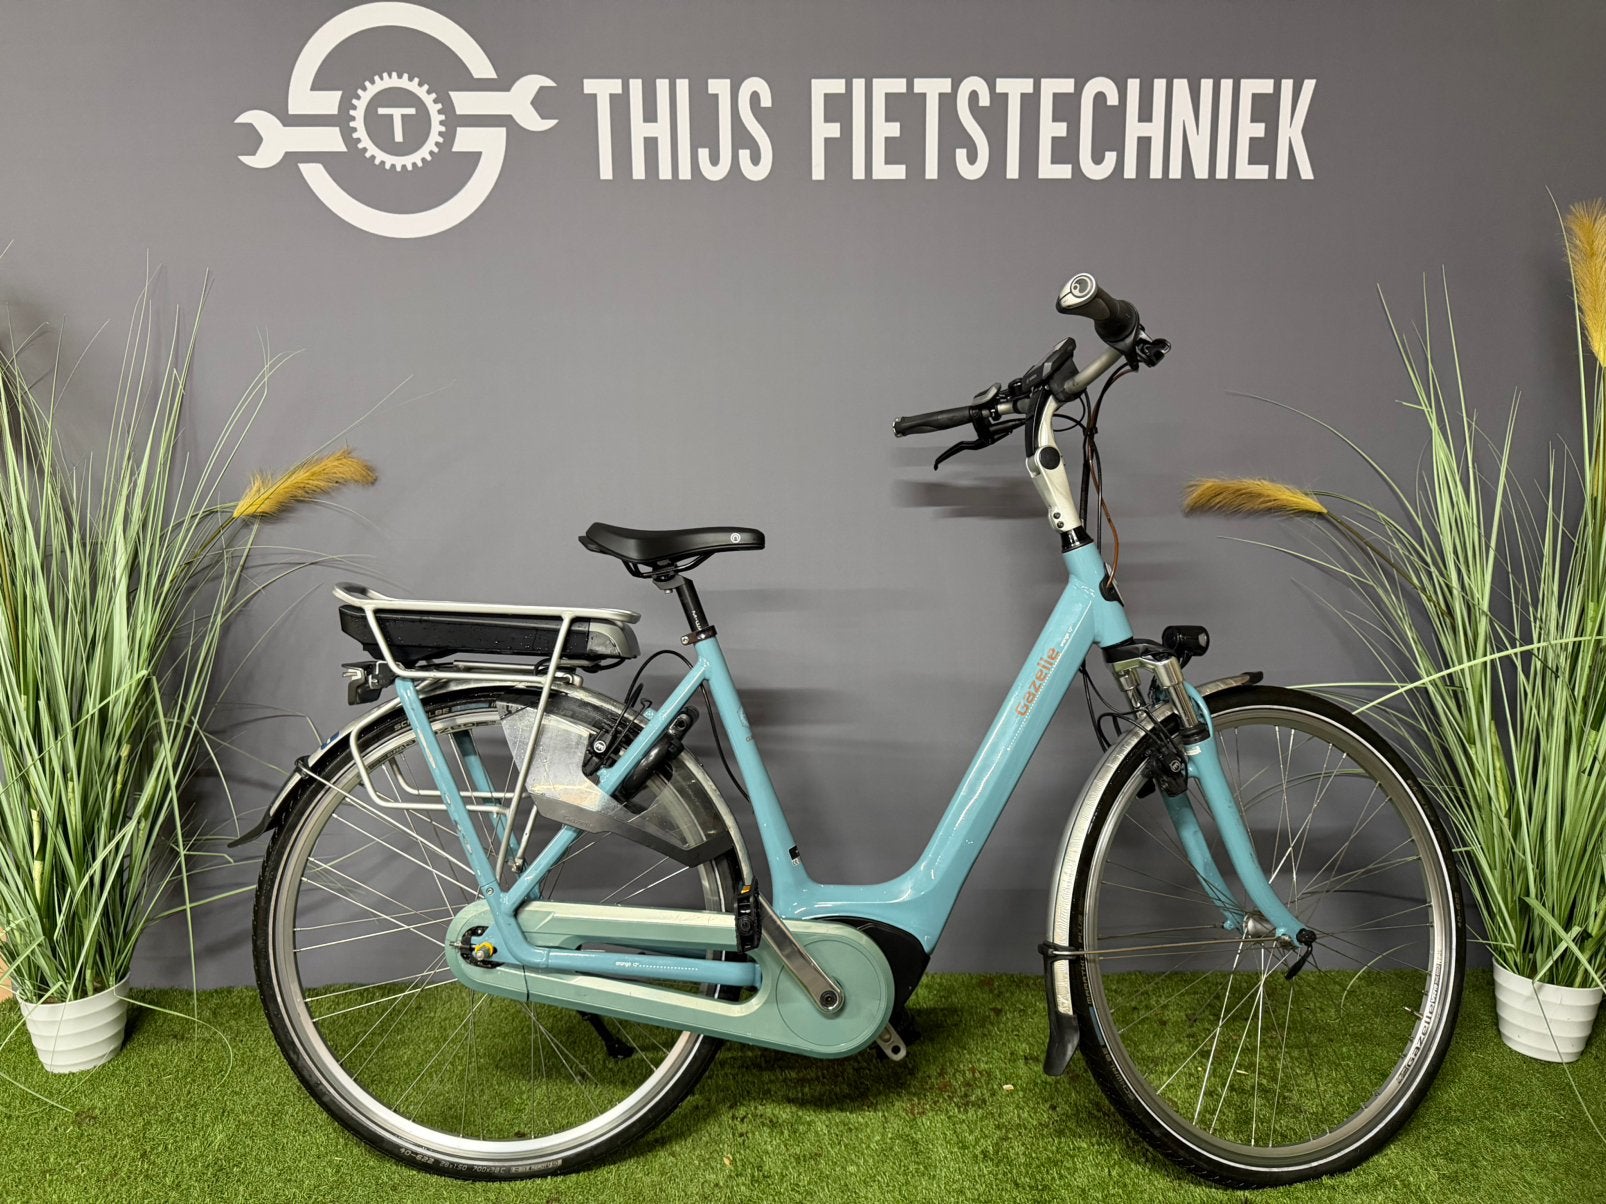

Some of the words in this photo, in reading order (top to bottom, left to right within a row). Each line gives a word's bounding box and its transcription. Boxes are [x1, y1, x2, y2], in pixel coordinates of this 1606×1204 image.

[378, 107, 416, 142] T
[583, 77, 773, 181] THIJS
[811, 76, 1316, 181] FIETSTECHNIEK
[1016, 648, 1060, 716] Gazelle
[1406, 1003, 1435, 1068] Gazelle
